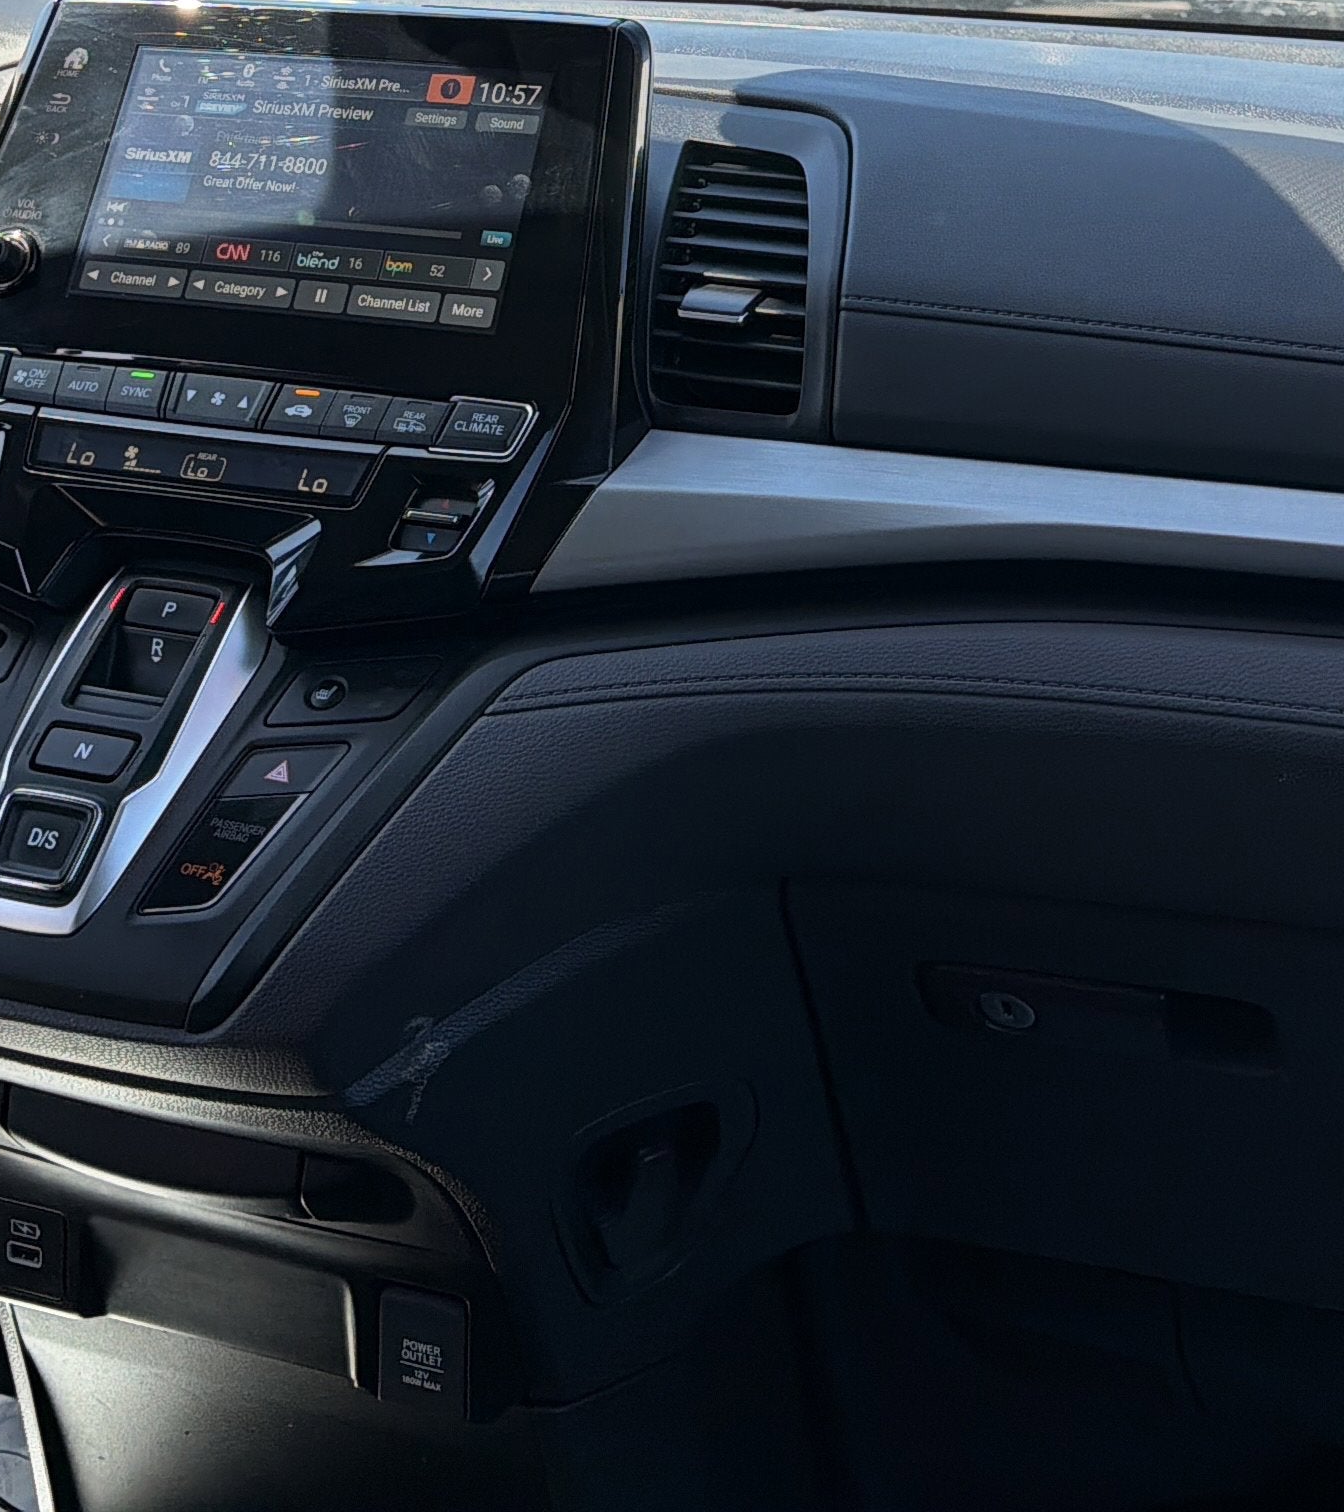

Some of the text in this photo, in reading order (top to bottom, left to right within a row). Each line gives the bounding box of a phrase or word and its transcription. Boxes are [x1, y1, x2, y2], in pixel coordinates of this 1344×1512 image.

[56, 69, 80, 78] HOME
[150, 73, 173, 82] Phone
[304, 74, 312, 86] 1
[320, 75, 376, 92] SiriusXM
[379, 78, 411, 95] Pre...
[479, 82, 543, 106] 10:57
[45, 104, 67, 113] BACK
[252, 98, 374, 122] SiriusXM Preview
[414, 112, 458, 127] Settings
[489, 116, 525, 130] Sound
[124, 147, 192, 164] SiriusXM
[209, 151, 328, 175] 844-711-8800
[203, 175, 297, 192] Great Offer Now!
[17, 199, 36, 209] VOL
[11, 208, 43, 220] AUDIO
[175, 242, 191, 254] 89
[487, 235, 503, 245] Live
[216, 243, 281, 262] CNN 116
[297, 253, 364, 270] blend 16
[385, 256, 446, 278] bpm 52
[110, 271, 156, 287] Channel
[214, 280, 267, 299] Category
[357, 294, 432, 313] Channel List
[451, 303, 484, 318] More
[29, 368, 51, 379] ON/
[25, 377, 47, 389] OFF
[67, 380, 99, 393] AUTO
[120, 385, 152, 399] SYNC
[342, 404, 373, 415] FRONT
[403, 410, 426, 420] REAR
[472, 411, 499, 424] REAR
[453, 420, 505, 436] CLIMATE
[66, 441, 96, 466] Lo
[196, 452, 219, 461] REAR
[186, 460, 209, 478] Lo
[297, 467, 328, 494] Lo
[161, 601, 177, 618] P
[150, 637, 164, 657] R
[73, 742, 94, 760] N
[210, 816, 267, 837] PASSENGER
[27, 827, 60, 850] D/S
[213, 828, 250, 844] AIRBAG
[180, 862, 208, 877] OFF
[402, 1338, 441, 1357] POWER
[401, 1348, 443, 1367] OUTLET
[414, 1369, 430, 1380] 12V
[423, 1379, 442, 1393] MAX
